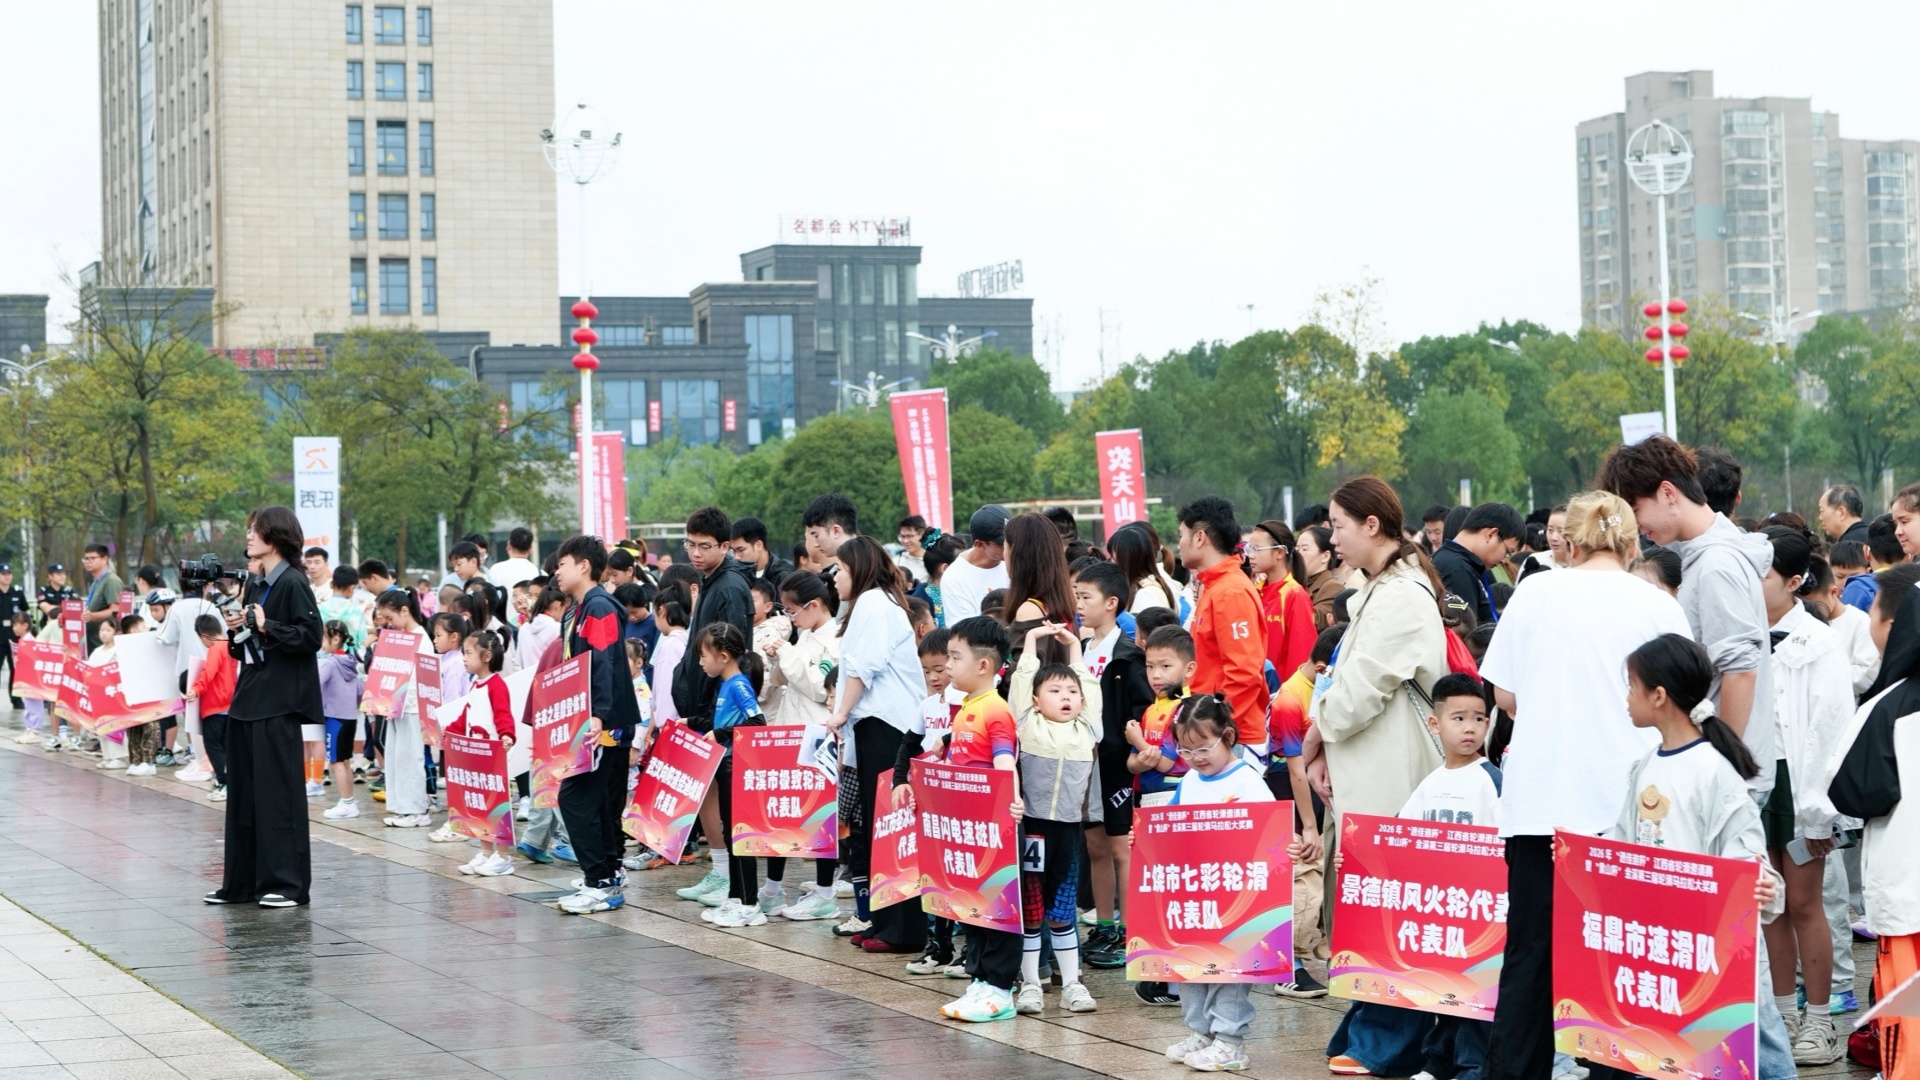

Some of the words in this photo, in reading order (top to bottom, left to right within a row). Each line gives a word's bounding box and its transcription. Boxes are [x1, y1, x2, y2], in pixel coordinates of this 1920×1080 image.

[1231, 621, 1250, 640] 15
[550, 723, 571, 748] 代表队
[925, 716, 954, 729] CHINA
[447, 765, 506, 793] 金溪县轮滑代表队
[743, 769, 827, 791] 贵溪市极致轮滑
[464, 790, 487, 811] 代表队
[653, 789, 679, 818] 代表队
[766, 796, 802, 818] 代表队
[921, 811, 1003, 850] 南昌闪电速桩队
[943, 848, 979, 879] 代表队
[1138, 861, 1269, 894] 上饶市七彩轮滑
[1341, 873, 1510, 924] 景德镇风火轮代表
[1166, 899, 1223, 930] 代表队
[1397, 920, 1468, 959] 代表队
[1582, 910, 1720, 976] 福鼎市速滑队
[1614, 965, 1683, 1017] 代表队
